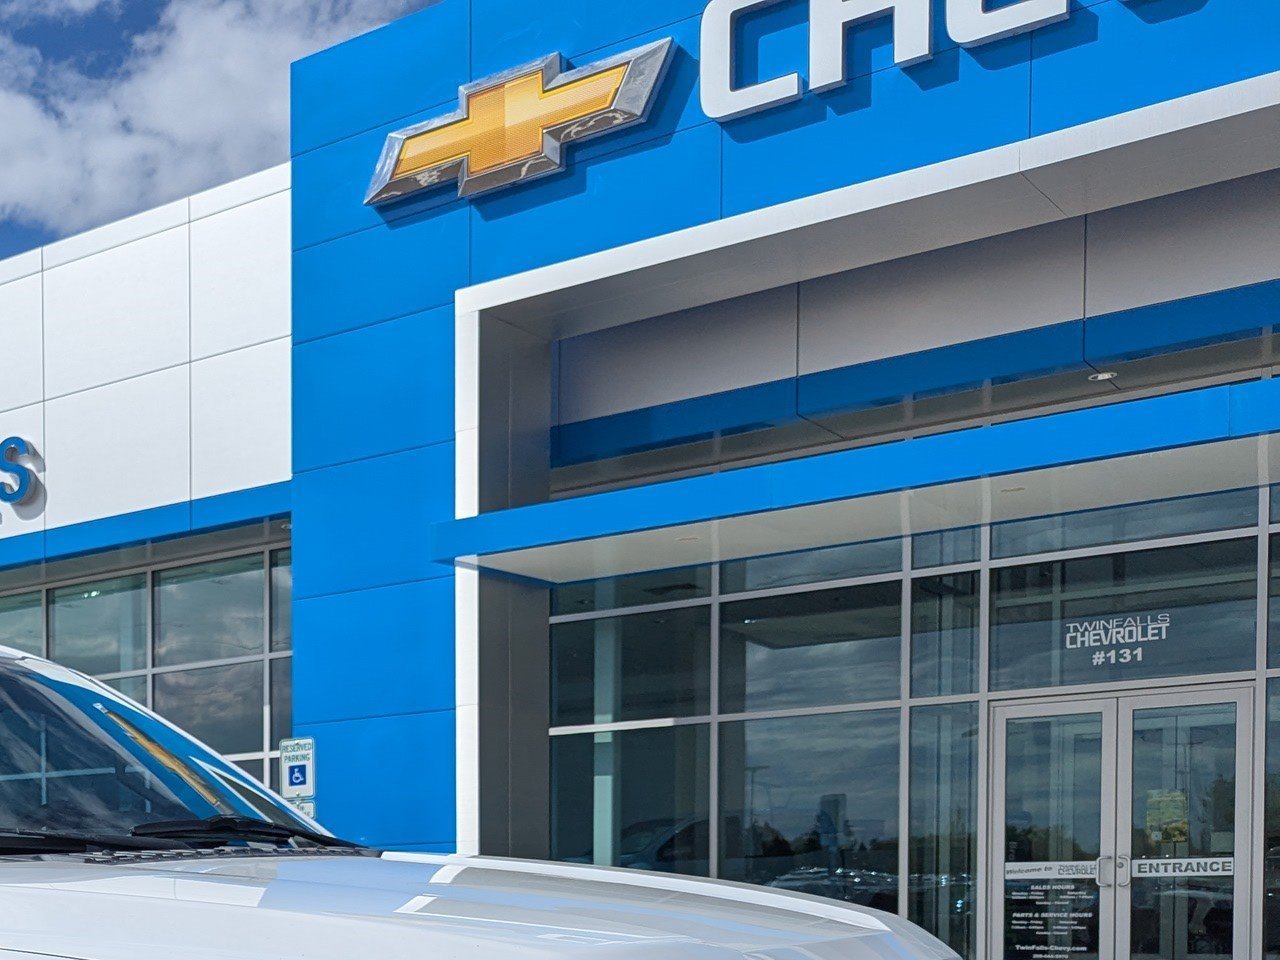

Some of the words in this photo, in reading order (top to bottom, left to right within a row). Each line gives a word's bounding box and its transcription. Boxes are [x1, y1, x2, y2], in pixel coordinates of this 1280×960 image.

[1066, 623, 1170, 649] CHEVROLET
[1092, 647, 1143, 666] #131
[282, 743, 312, 753] RESERVED
[284, 753, 311, 763] PARKING
[1137, 860, 1233, 874] ENTRANCE
